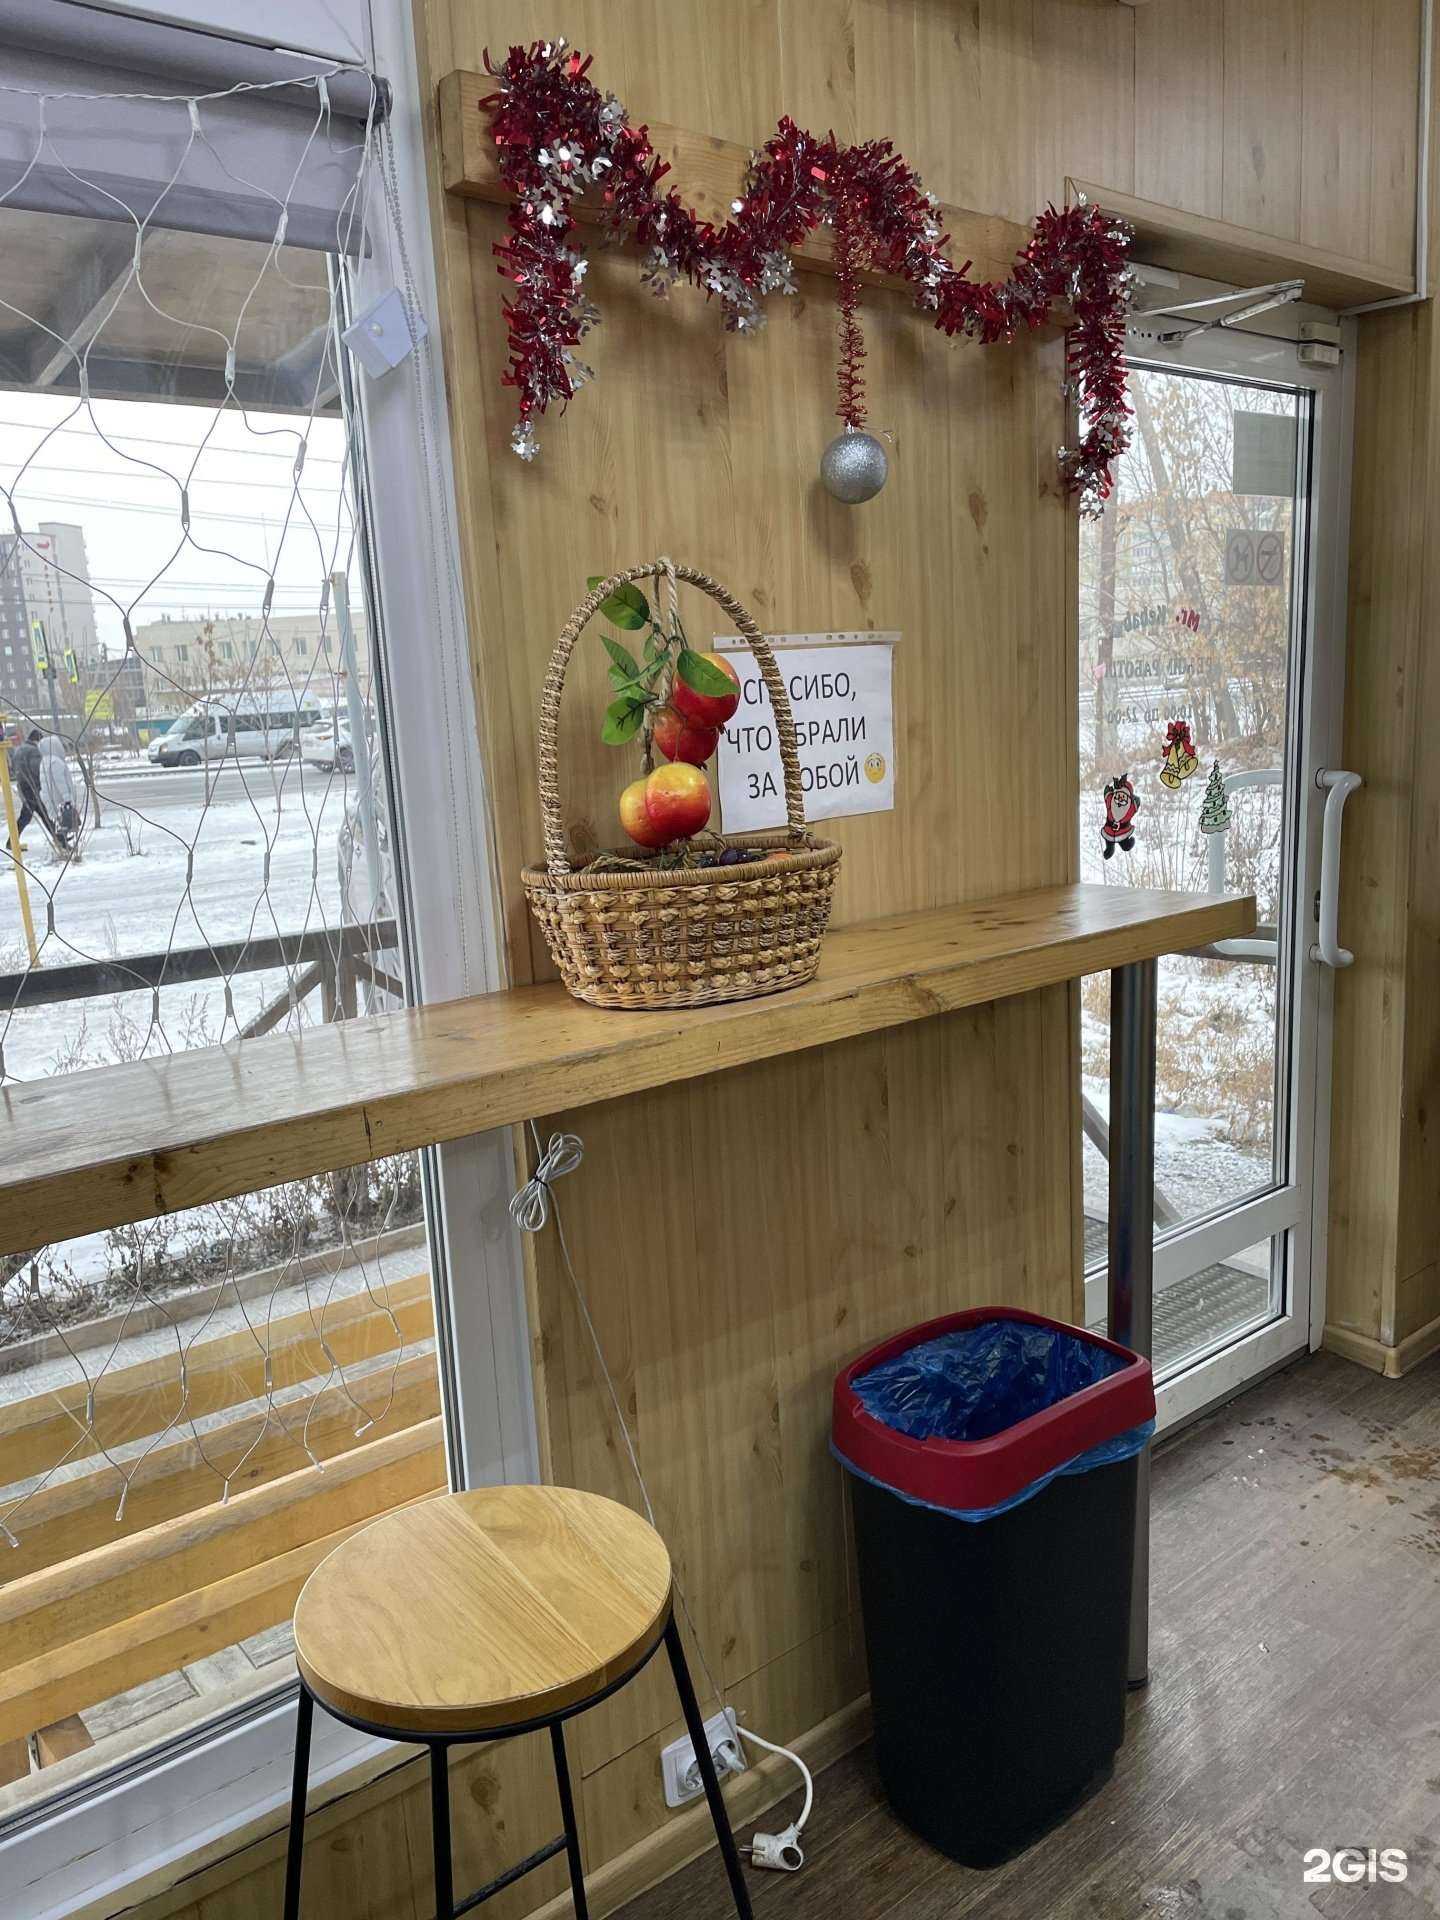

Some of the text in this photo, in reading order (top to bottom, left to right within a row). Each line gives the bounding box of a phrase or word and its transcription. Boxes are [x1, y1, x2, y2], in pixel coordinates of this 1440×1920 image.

[743, 672, 857, 705] СПСИБО,
[727, 725, 773, 754] ЧТО
[747, 771, 778, 799] ЗА
